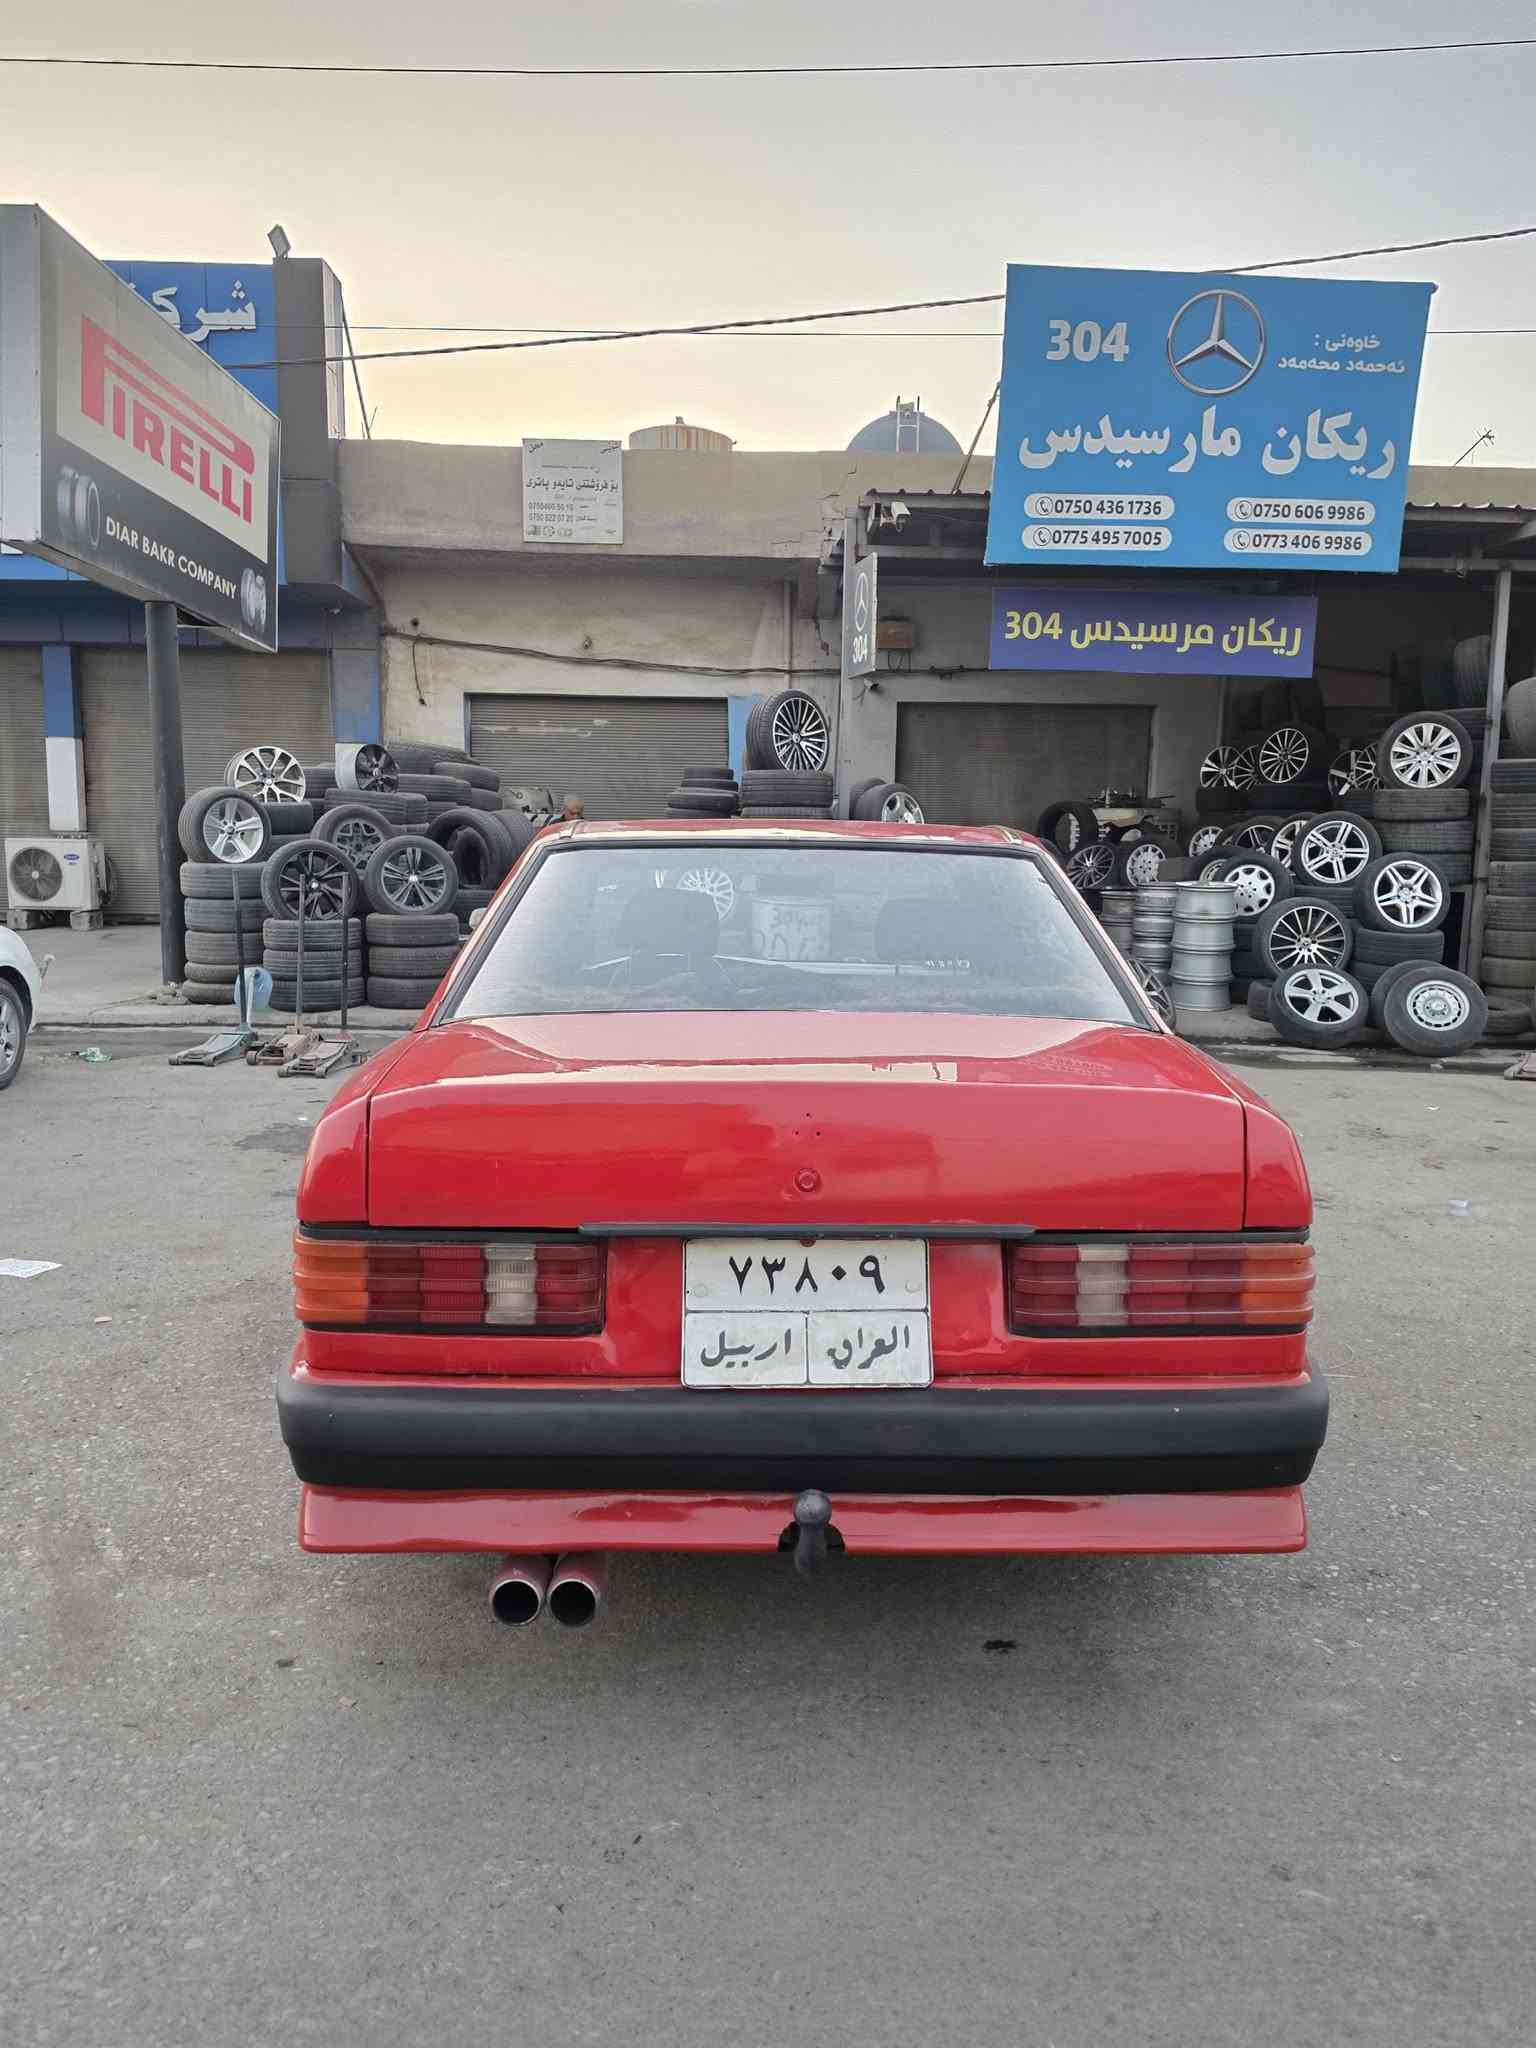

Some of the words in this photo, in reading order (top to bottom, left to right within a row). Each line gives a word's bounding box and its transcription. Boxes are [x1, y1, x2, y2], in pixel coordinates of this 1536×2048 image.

[1046, 319, 1129, 363] 304
[81, 314, 255, 524] PIRELLI
[1054, 499, 1093, 513] 0750
[1095, 499, 1124, 514] 436
[1127, 500, 1162, 515] 1736
[1253, 503, 1291, 518] 0750
[1294, 504, 1324, 519] 606
[1327, 506, 1365, 520] 9986
[1052, 530, 1088, 544] 0775
[1091, 530, 1120, 545] 495
[1123, 531, 1162, 545] 7005
[1252, 534, 1288, 548] 0773
[1291, 535, 1321, 549] 406
[1324, 536, 1362, 550] 9986
[106, 516, 139, 549] DIAR
[142, 535, 175, 568] BAKR
[178, 555, 237, 600] COMPANY
[1005, 610, 1063, 640] 304
[852, 633, 868, 664] 304
[728, 1254, 886, 1295] ٧٣٨٠٩
[827, 1325, 910, 1370] العراق
